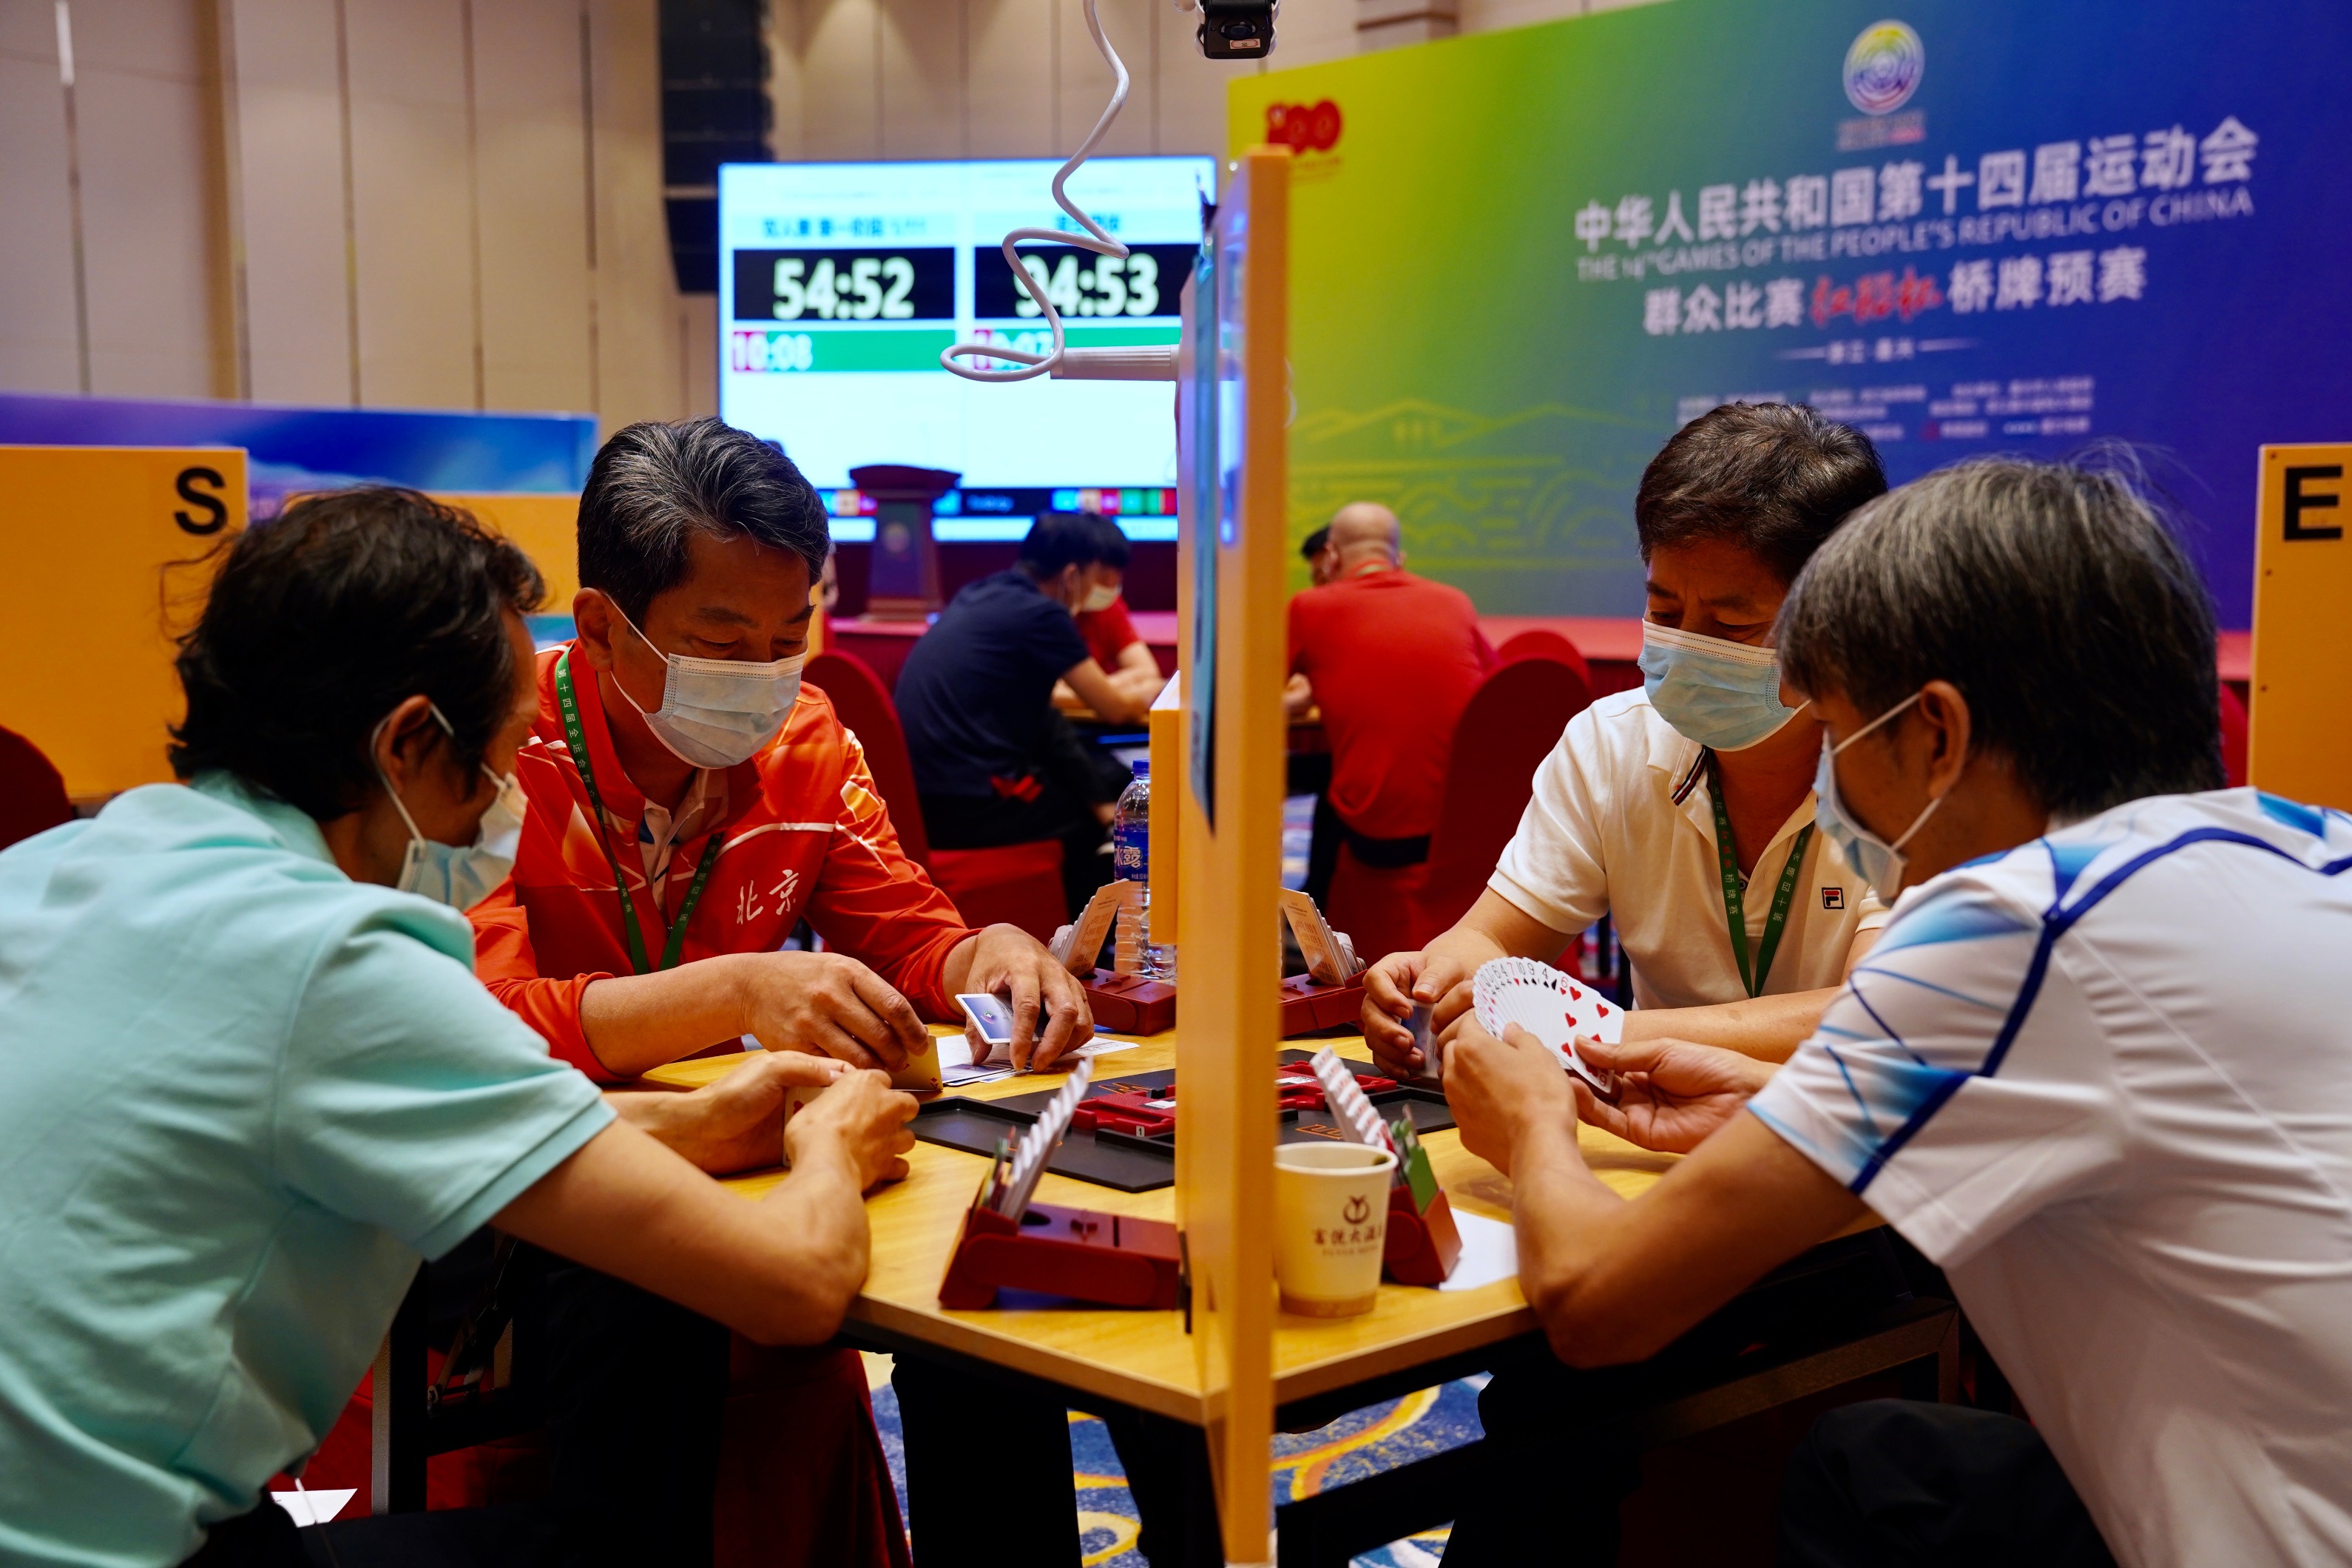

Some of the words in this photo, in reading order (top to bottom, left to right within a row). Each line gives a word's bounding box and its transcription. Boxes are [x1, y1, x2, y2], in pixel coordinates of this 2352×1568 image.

[1575, 115, 2258, 252] 中华人民共和国第十四届运动会
[1958, 202, 2099, 245] REPUBLIC
[2101, 197, 2145, 232] OF
[2148, 186, 2254, 227] CHINA
[773, 257, 915, 320] 54:52
[1643, 277, 1805, 337] 群众比赛
[1947, 244, 2147, 314] 桥牌预赛
[174, 466, 229, 536] S
[2283, 465, 2344, 541] E
[737, 869, 800, 925] 北京
[1527, 962, 1535, 976] 9
[1561, 976, 1569, 988] 6
